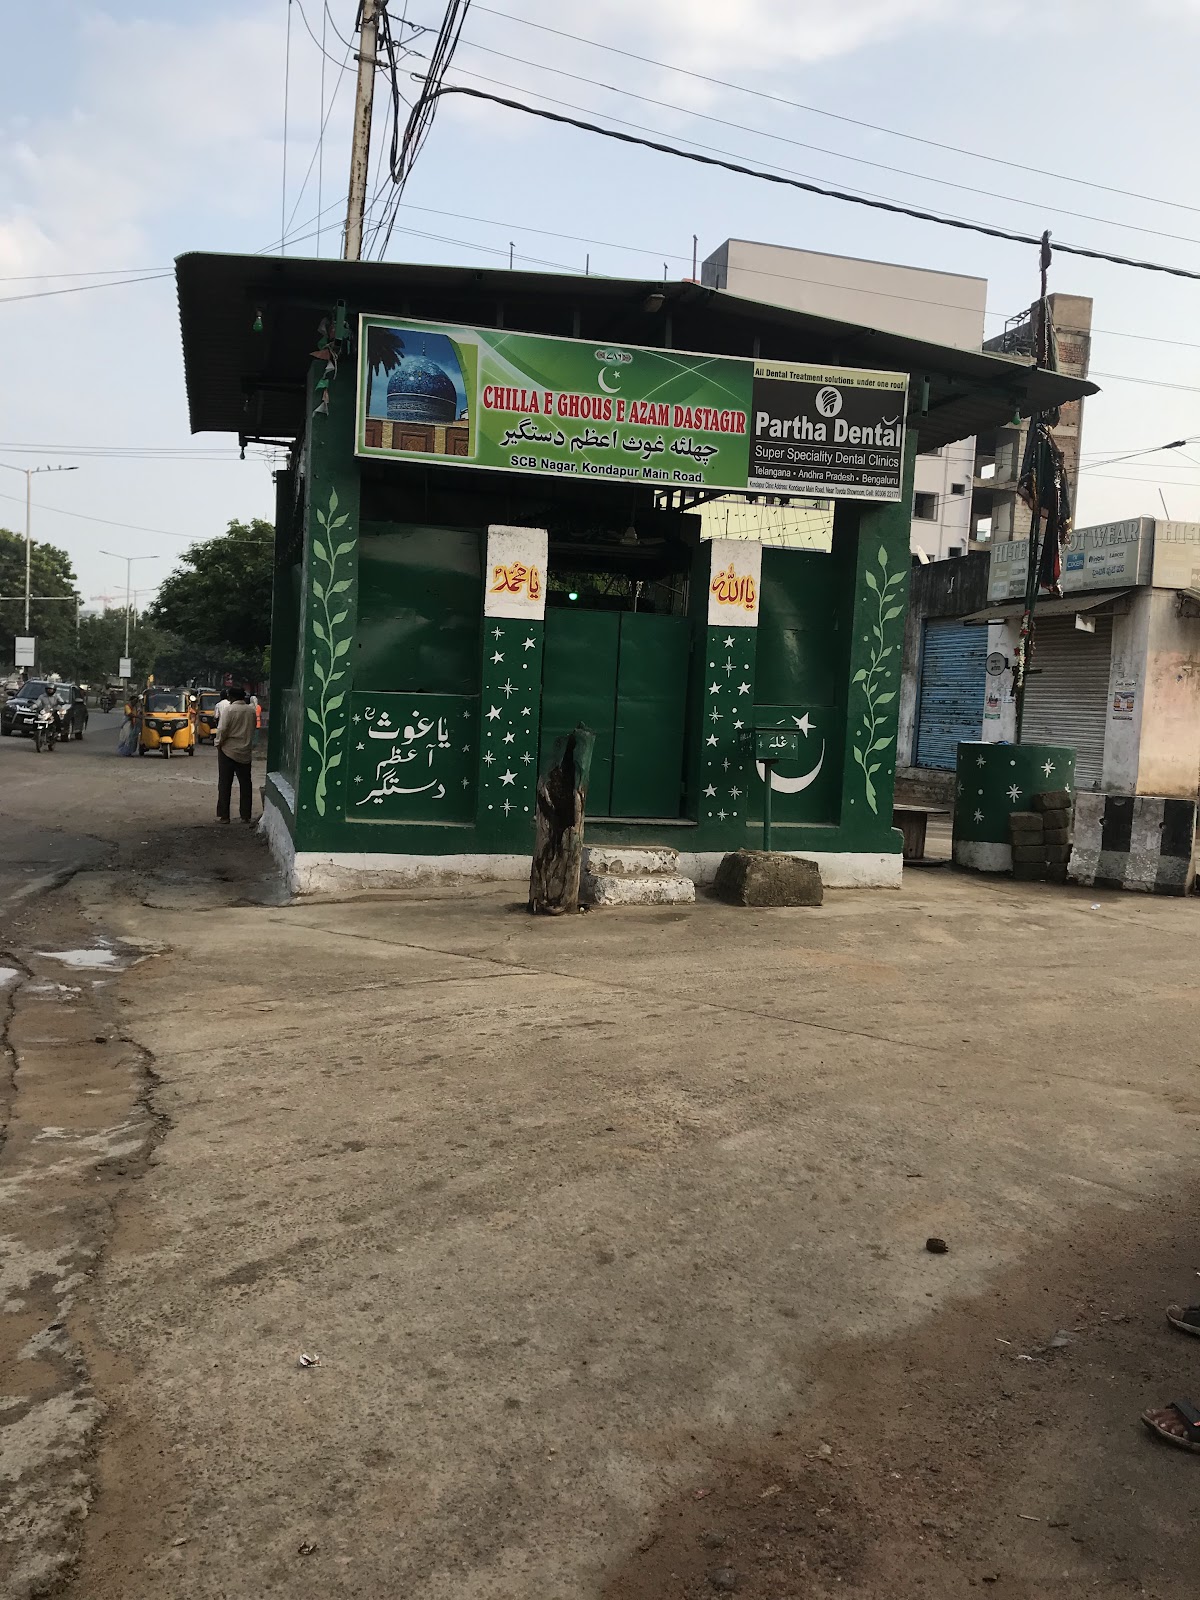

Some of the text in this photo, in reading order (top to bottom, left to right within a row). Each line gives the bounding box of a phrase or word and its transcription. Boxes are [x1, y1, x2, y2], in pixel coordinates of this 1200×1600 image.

[755, 368, 764, 377] All
[766, 369, 788, 379] Dental
[790, 372, 823, 382] Treatment
[825, 376, 854, 385] solutions
[857, 379, 876, 387] under
[890, 382, 904, 390] roof
[483, 385, 746, 433] CHILLA E GHOUS E AZAM DASTAGIR
[570, 428, 618, 452] اعظم
[755, 411, 901, 447] Partha Dental
[622, 435, 664, 460] غوث
[755, 445, 899, 467] Super Speciality Dental Clinics
[511, 456, 705, 482] SCB Nagar, Kondapur Main Road.
[754, 466, 898, 485] Telangana Andhra Pradesh Bengaluru
[788, 484, 805, 492] Kondapur
[826, 486, 835, 494] Near
[1090, 521, 1139, 548] WEAR
